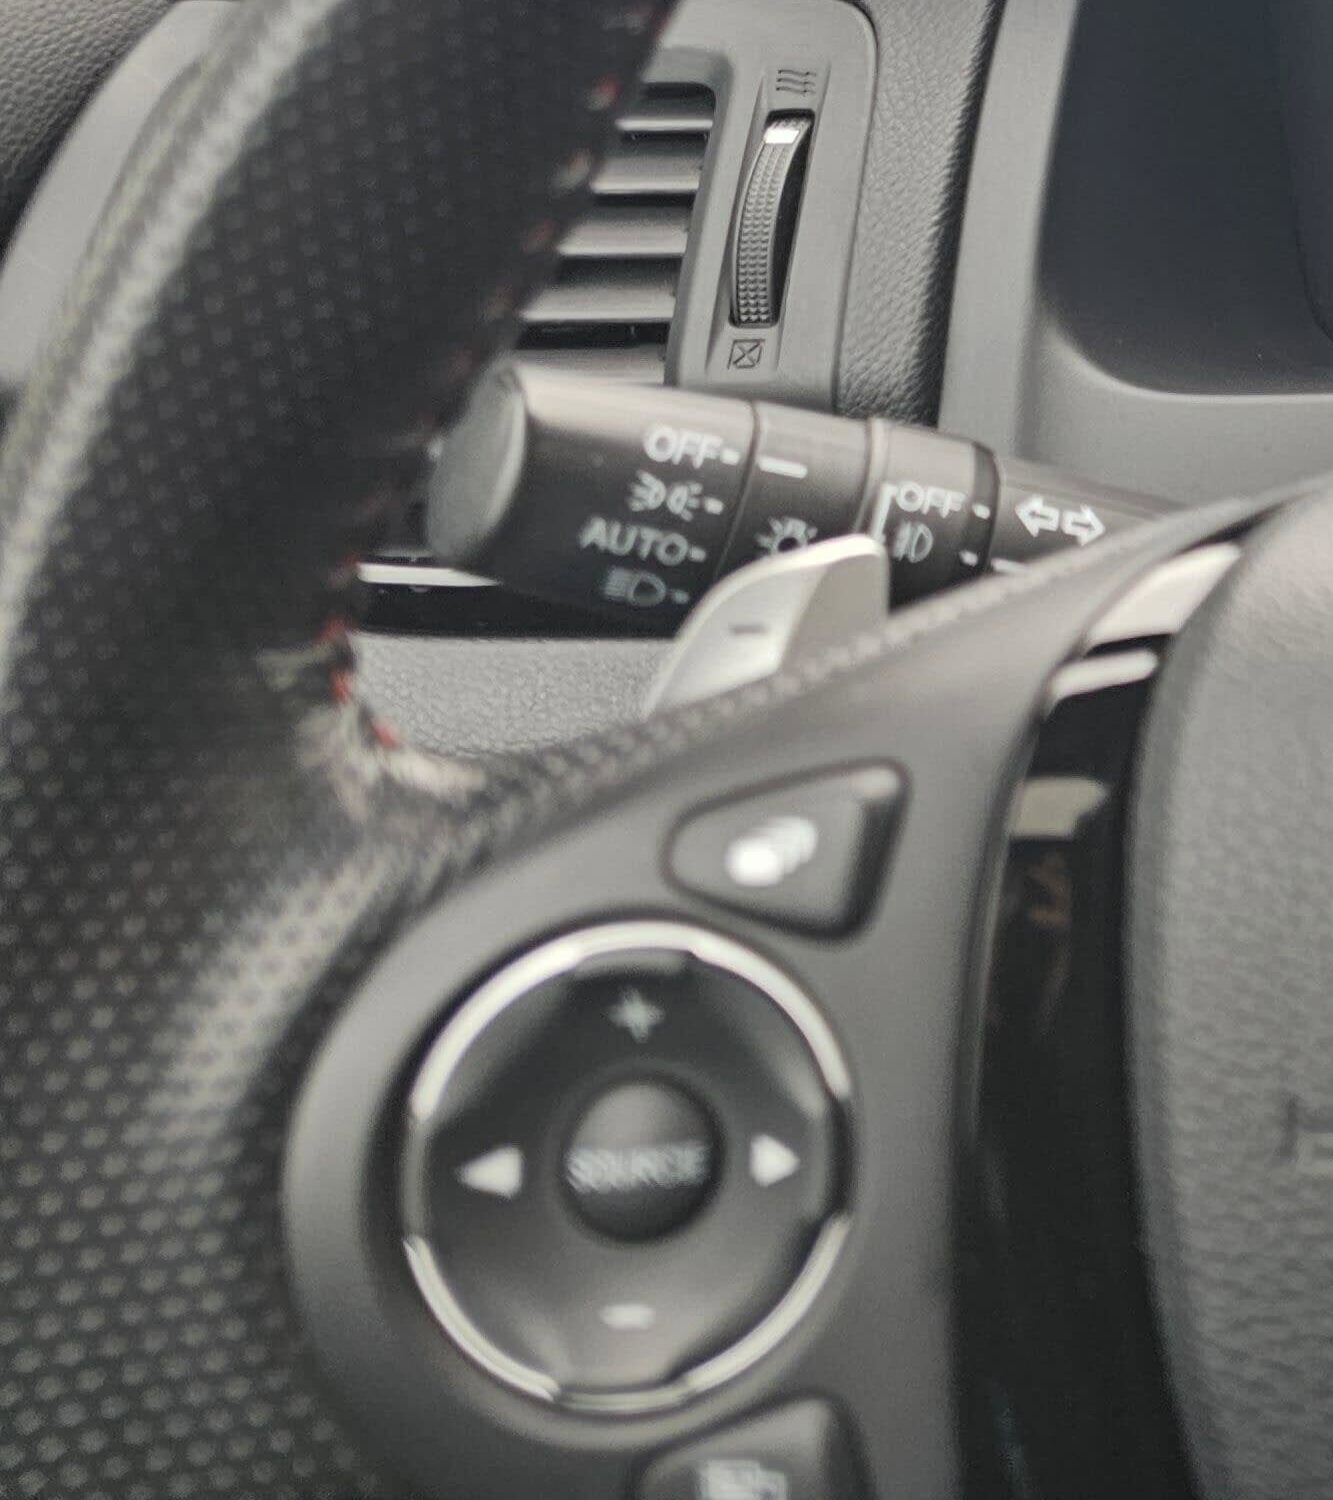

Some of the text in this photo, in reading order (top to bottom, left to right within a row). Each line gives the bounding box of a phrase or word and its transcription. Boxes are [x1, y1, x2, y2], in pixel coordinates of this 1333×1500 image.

[642, 424, 724, 469] OFF
[896, 485, 964, 517] OFF
[579, 517, 688, 567] AUTO
